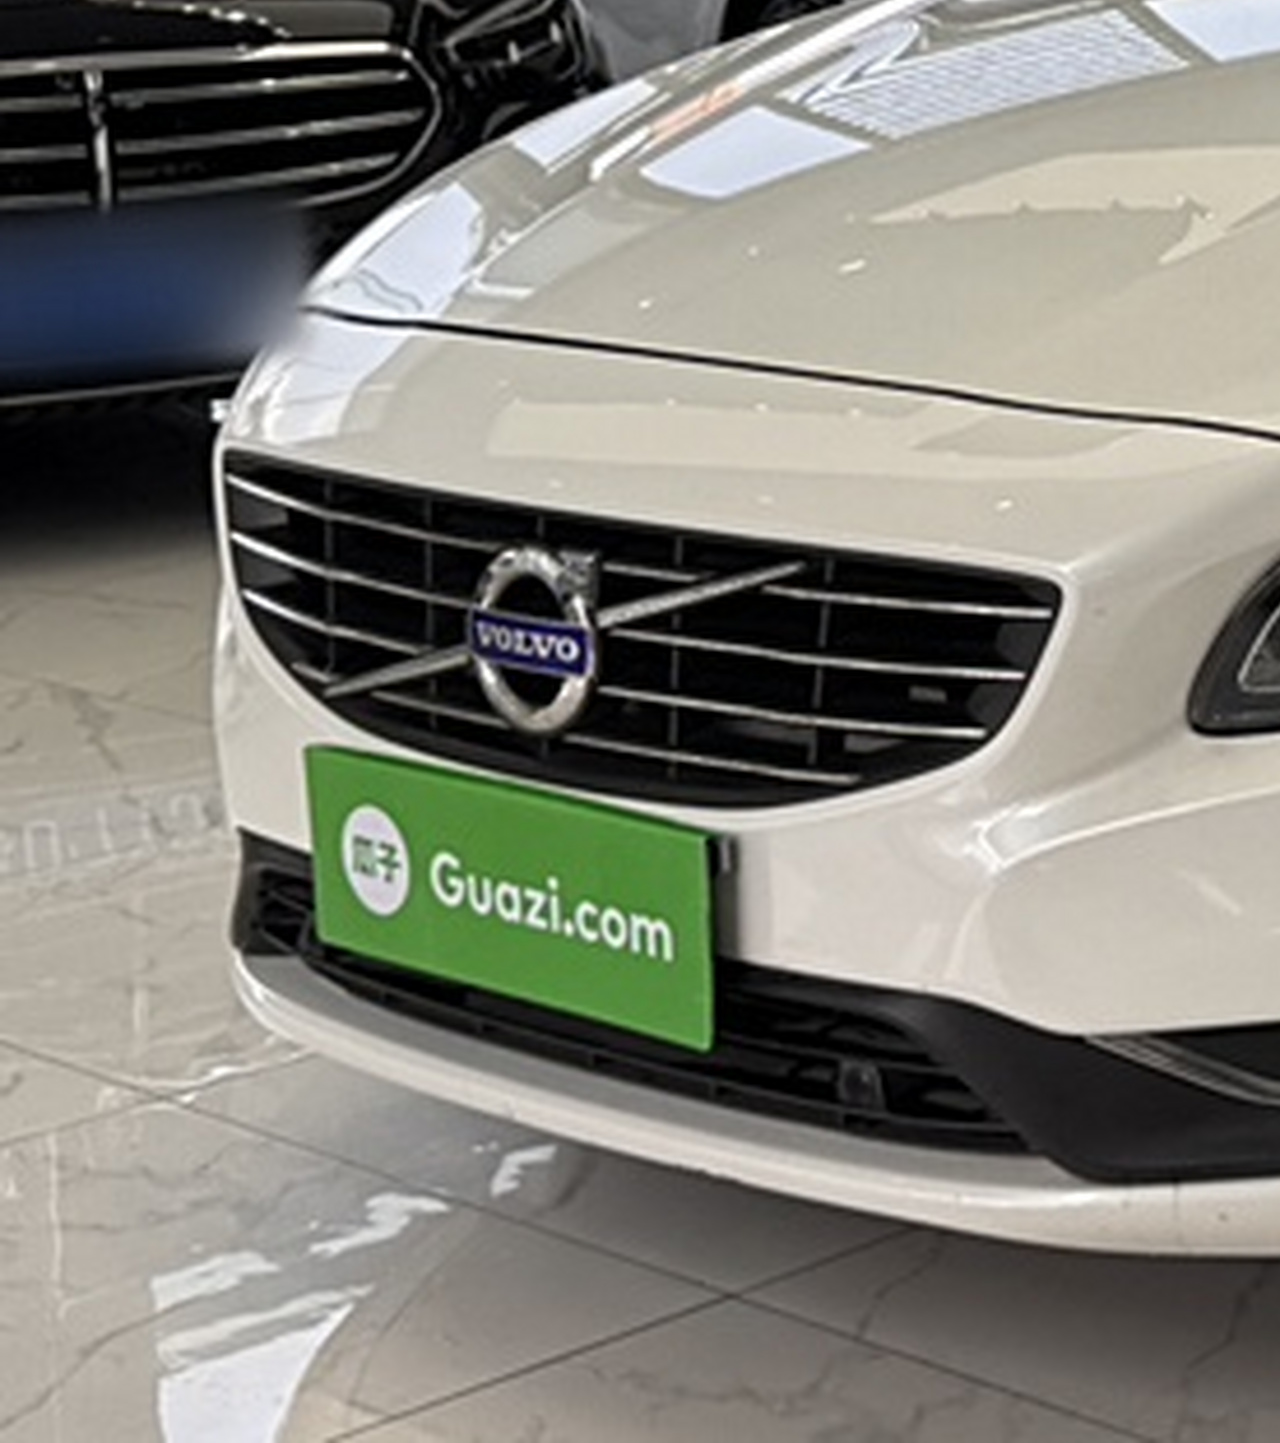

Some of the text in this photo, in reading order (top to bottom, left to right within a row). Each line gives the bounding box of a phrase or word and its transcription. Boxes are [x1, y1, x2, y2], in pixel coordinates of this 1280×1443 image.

[476, 620, 580, 663] VOLVO
[351, 833, 402, 884] 瓜子
[429, 851, 675, 963] Guazi.com
